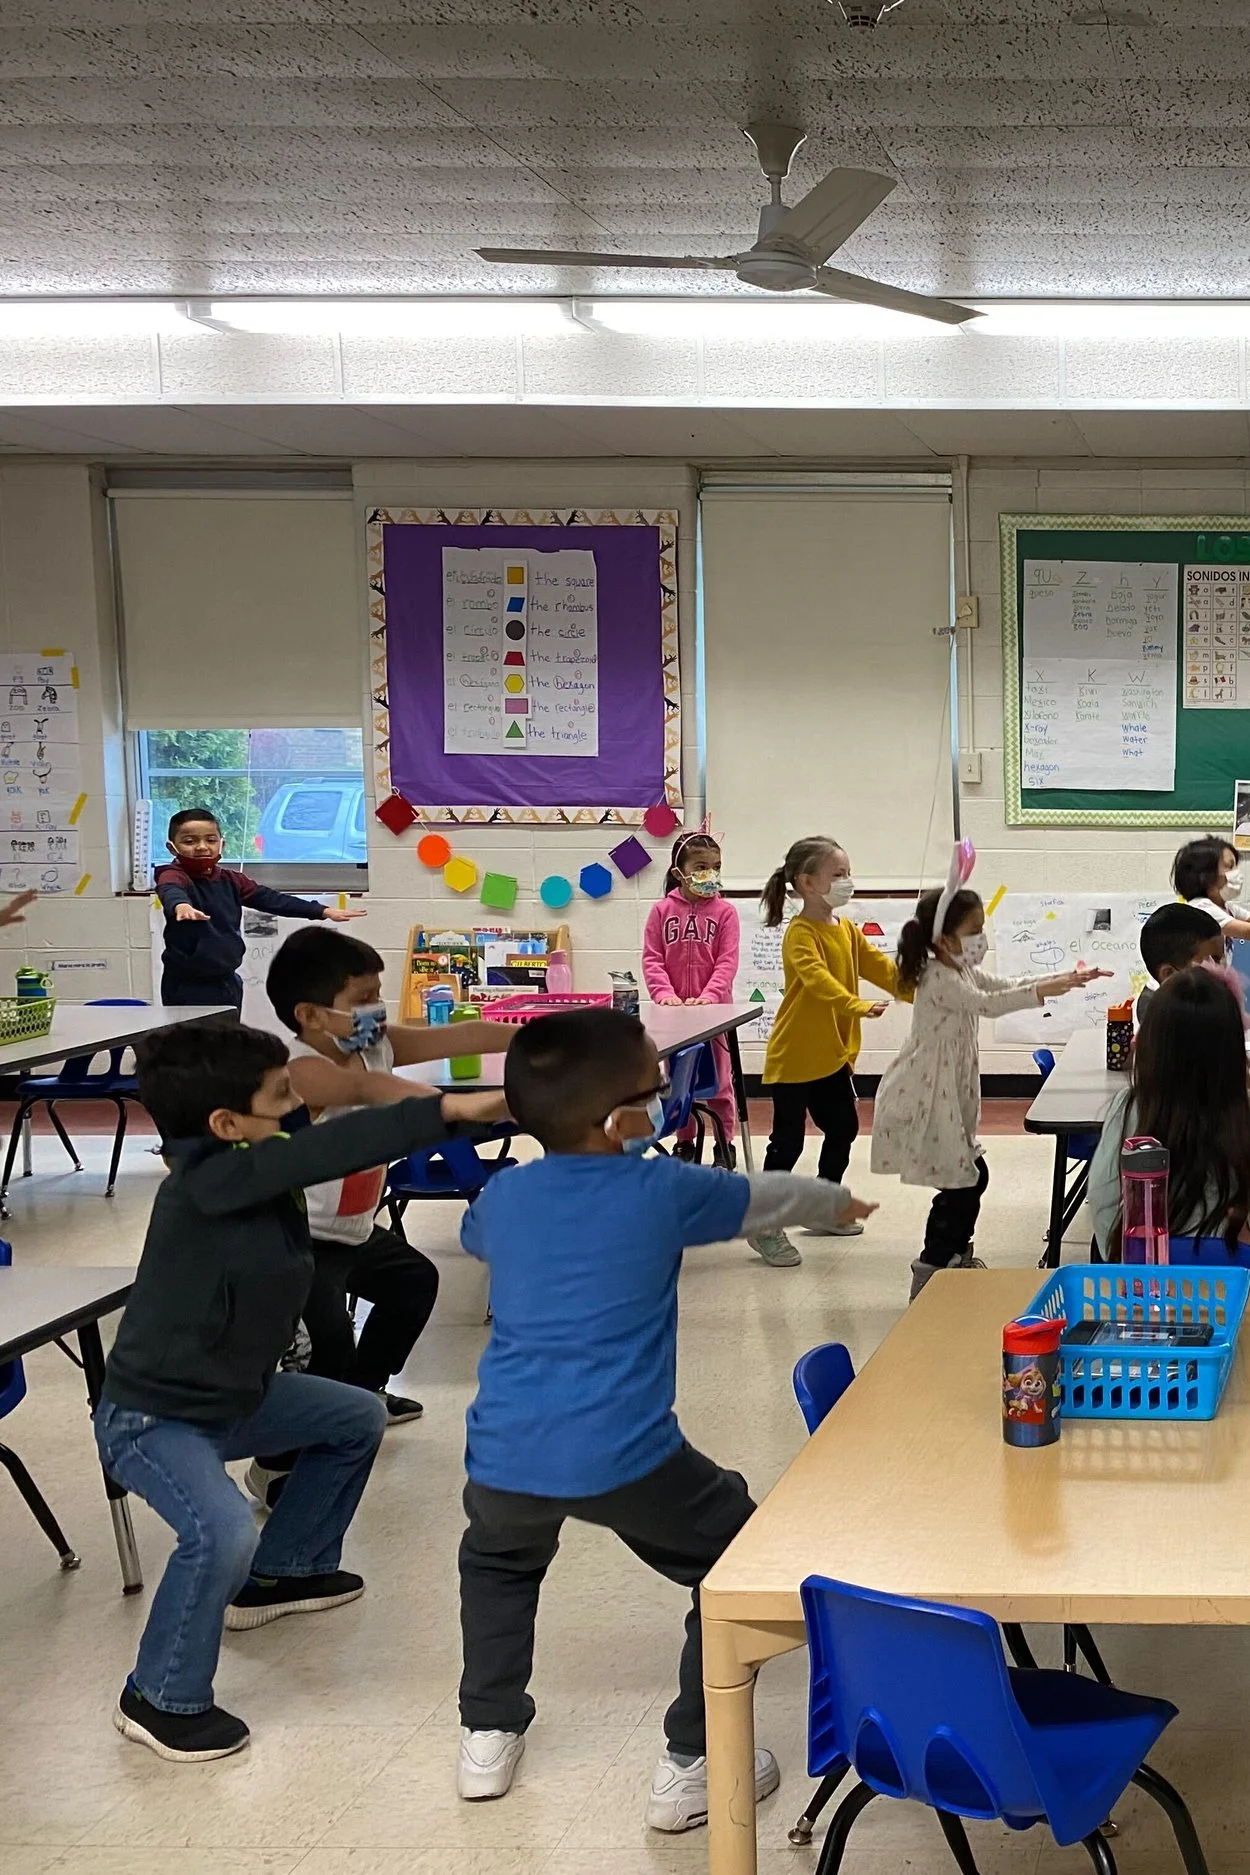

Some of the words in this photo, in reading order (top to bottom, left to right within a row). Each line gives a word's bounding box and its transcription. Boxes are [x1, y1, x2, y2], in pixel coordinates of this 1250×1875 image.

[535, 572, 559, 586] the
[566, 576, 594, 589] square
[1187, 571, 1236, 581] SONIDOS
[531, 598, 548, 611] the
[555, 603, 593, 612] rhombus
[531, 624, 550, 637] the
[559, 628, 586, 638] circle
[530, 652, 549, 662] the
[529, 676, 550, 687] the
[532, 701, 549, 712] the
[528, 724, 545, 738] the
[552, 725, 587, 744] triangle
[1024, 760, 1059, 774] hexagon
[664, 914, 719, 944] GAP
[1070, 938, 1081, 952] el
[1092, 940, 1137, 950] oceano
